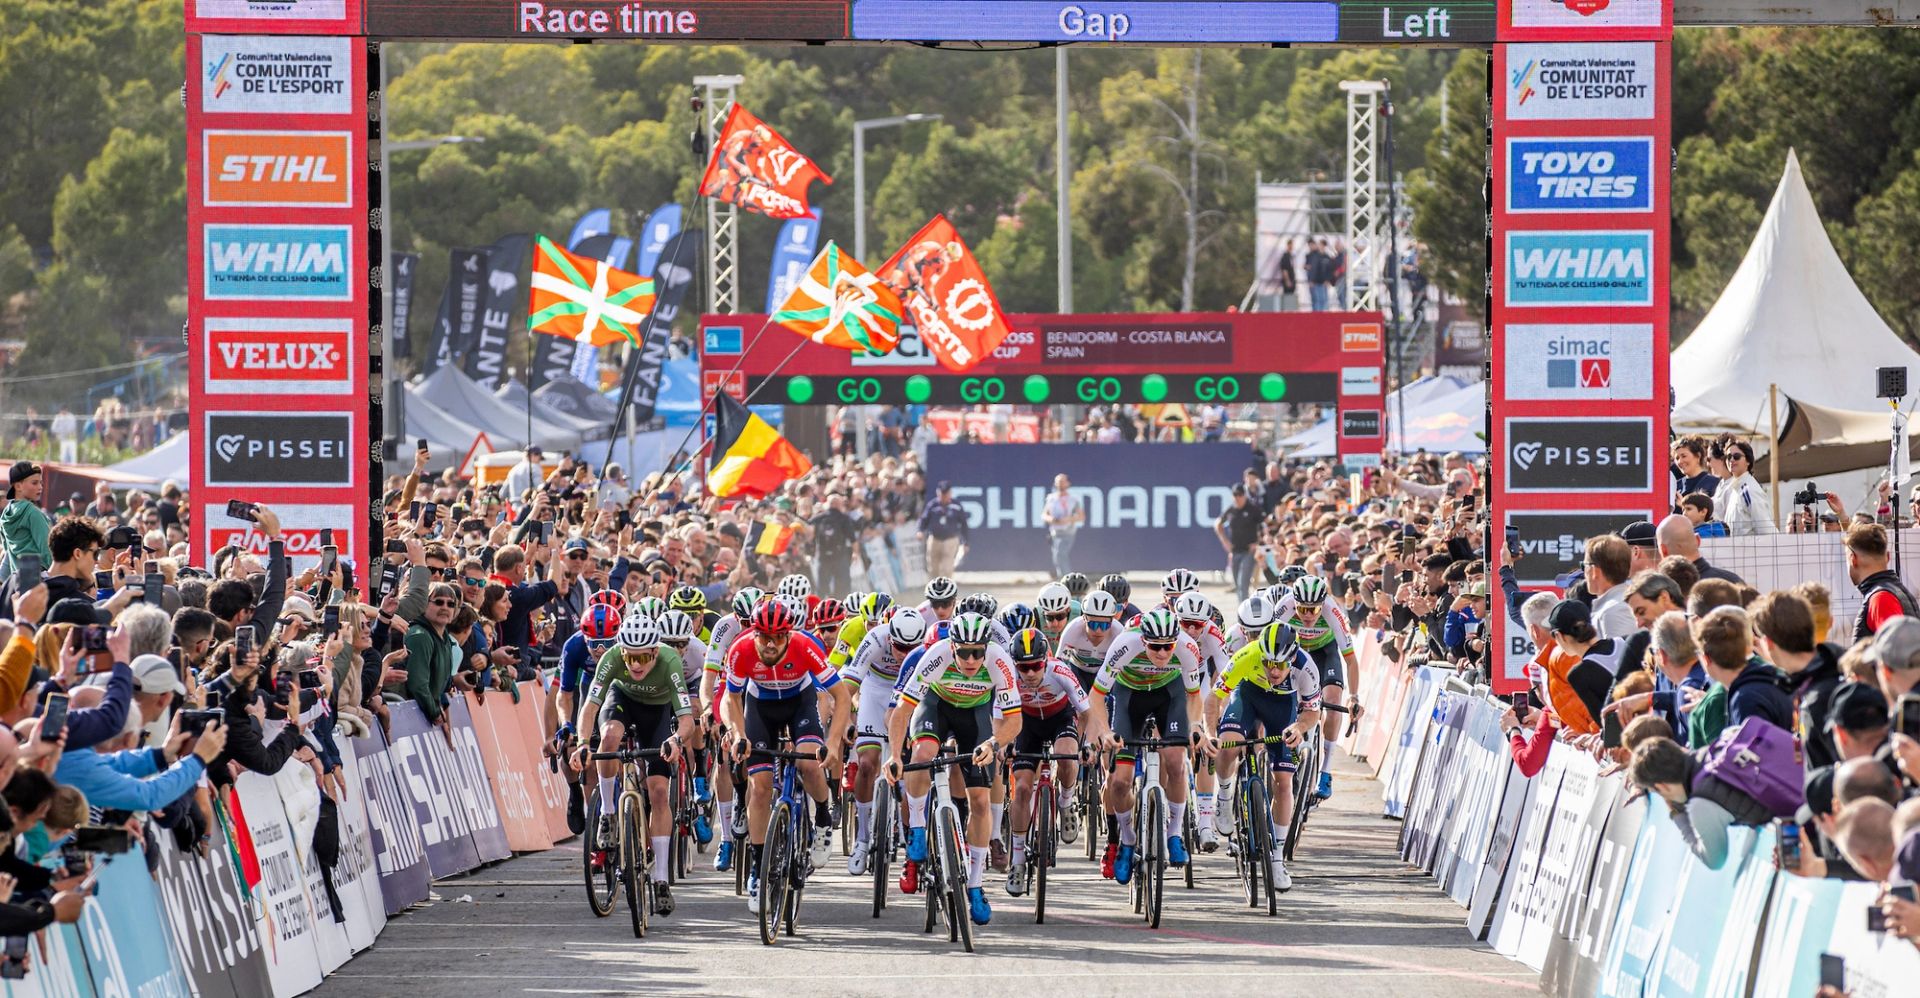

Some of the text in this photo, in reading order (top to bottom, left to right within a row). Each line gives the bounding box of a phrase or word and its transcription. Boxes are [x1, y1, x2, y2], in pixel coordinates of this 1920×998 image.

[520, 2, 696, 33] Race time
[1058, 6, 1130, 39] Gap
[1383, 7, 1450, 37] Left
[236, 53, 332, 61] Comunitat Valenciana
[1540, 59, 1636, 67] Comunitat Valenciana
[236, 64, 332, 78] COMUNITAT
[1540, 70, 1635, 84] COMUNITAT
[243, 80, 264, 93] DE
[1547, 85, 1568, 99] DE
[219, 155, 337, 182] STIHL
[1522, 151, 1615, 174] TOYO
[1537, 176, 1637, 198] TIRES
[211, 242, 344, 273] WHIM
[1513, 248, 1645, 278] WHIM
[1047, 332, 1118, 344] BENIDORM
[1128, 331, 1173, 344] COSTA
[1175, 331, 1226, 344] BLANCA
[1344, 332, 1379, 342] STIHL
[1547, 336, 1610, 355] simac
[993, 347, 1020, 359] CUP
[1047, 346, 1085, 359] SPAIN
[837, 376, 1240, 402] GO GO GO GO
[248, 440, 344, 458] PISSEI
[1545, 447, 1640, 465] PISSEI
[714, 622, 731, 643] crelan
[806, 647, 826, 669] TREK
[1109, 645, 1129, 667] crelan
[922, 655, 944, 677] crelan
[592, 687, 598, 695] 5
[955, 681, 987, 691] crelan
[1078, 689, 1084, 697] 9
[684, 696, 689, 706] 5
[179, 846, 259, 970] PISSE
